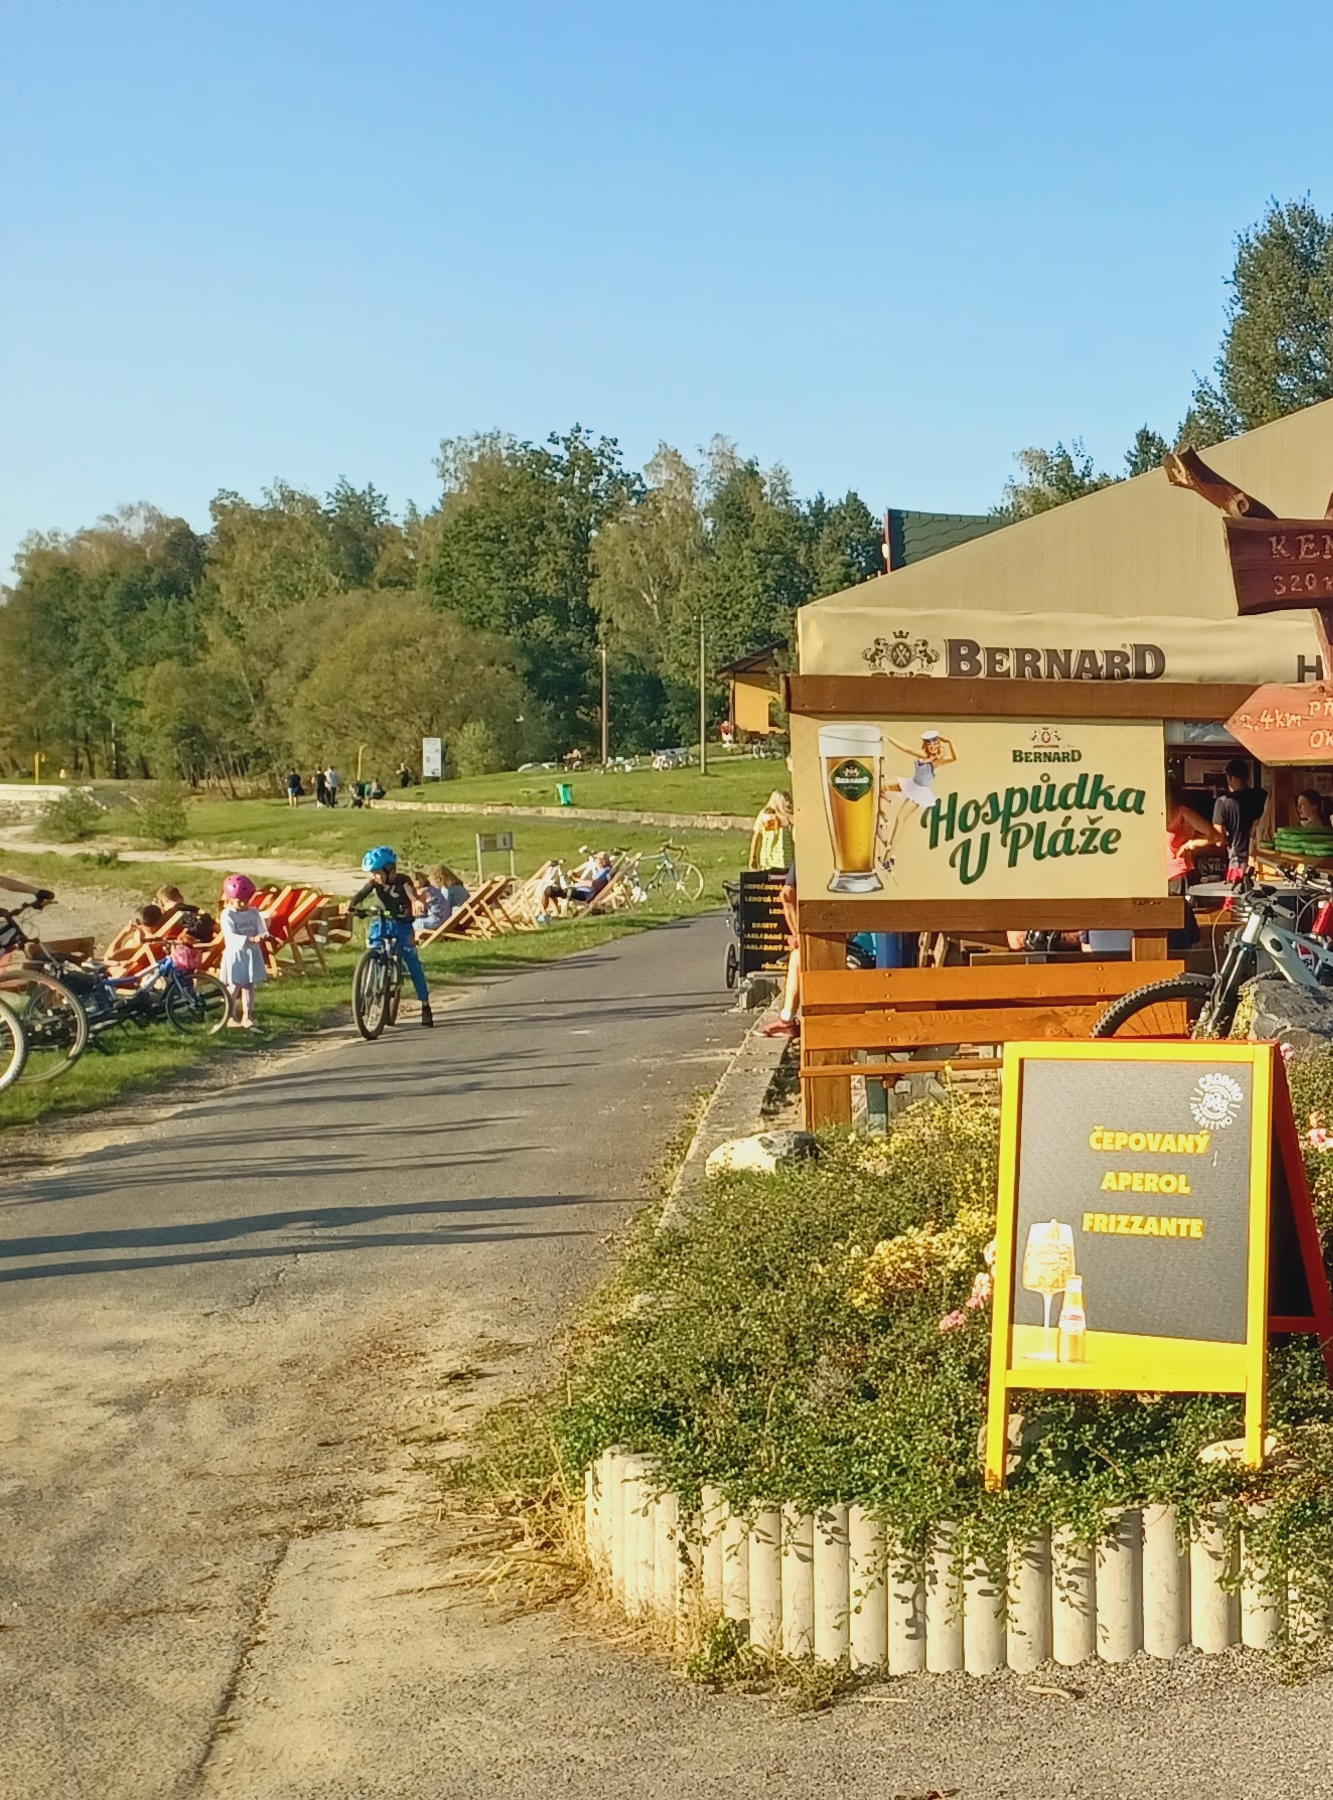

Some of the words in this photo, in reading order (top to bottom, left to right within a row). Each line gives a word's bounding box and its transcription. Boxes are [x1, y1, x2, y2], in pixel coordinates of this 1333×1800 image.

[1273, 573, 1318, 596] 320
[944, 638, 1166, 682] BERNARD
[1012, 750, 1082, 763] BERNARD
[920, 773, 1146, 850] Hospůdka
[949, 832, 990, 886] U
[1001, 816, 1122, 869] Pláže
[1089, 1125, 1210, 1154] ČEPOVANÝ
[1101, 1171, 1191, 1195] APEROL
[1082, 1213, 1204, 1239] FRIZZANTE
